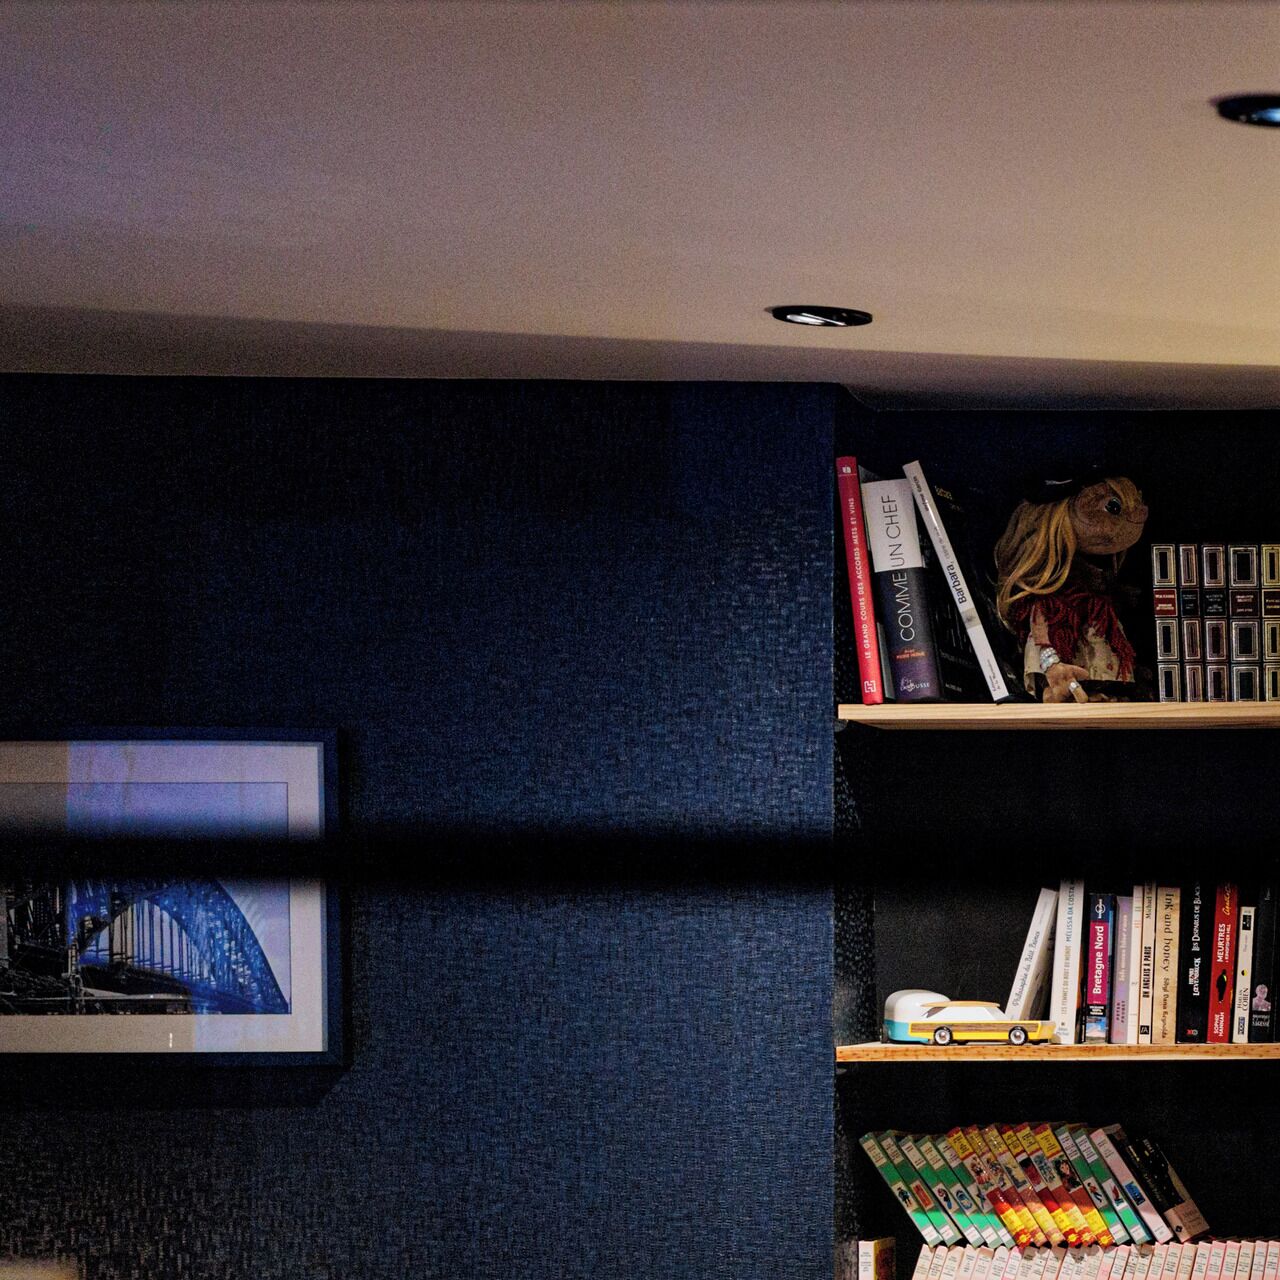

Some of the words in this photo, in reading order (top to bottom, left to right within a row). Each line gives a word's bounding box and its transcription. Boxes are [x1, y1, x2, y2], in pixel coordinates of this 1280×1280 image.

[881, 494, 902, 540] CHEF
[851, 526, 859, 545] METS
[853, 546, 863, 580] ACCORDS
[888, 543, 905, 569] UN
[856, 581, 865, 595] DES
[946, 560, 967, 605] Barbara,
[858, 597, 867, 621] COURS
[891, 571, 915, 642] COMME
[861, 623, 869, 649] GRAND
[1068, 906, 1074, 915] DA
[1164, 893, 1174, 910] Ink
[1163, 913, 1173, 934] and
[1192, 913, 1201, 941] DISPARUS
[1094, 925, 1104, 949] Nord
[1192, 941, 1200, 951] LES
[1216, 923, 1226, 963] MEURTRES
[1144, 945, 1152, 961] PARIS
[1160, 938, 1171, 972] honey
[1012, 973, 1028, 1007] Philosophie
[1029, 931, 1041, 949] Prince
[1093, 952, 1104, 995] Bretagne
[1142, 990, 1150, 998] UN
